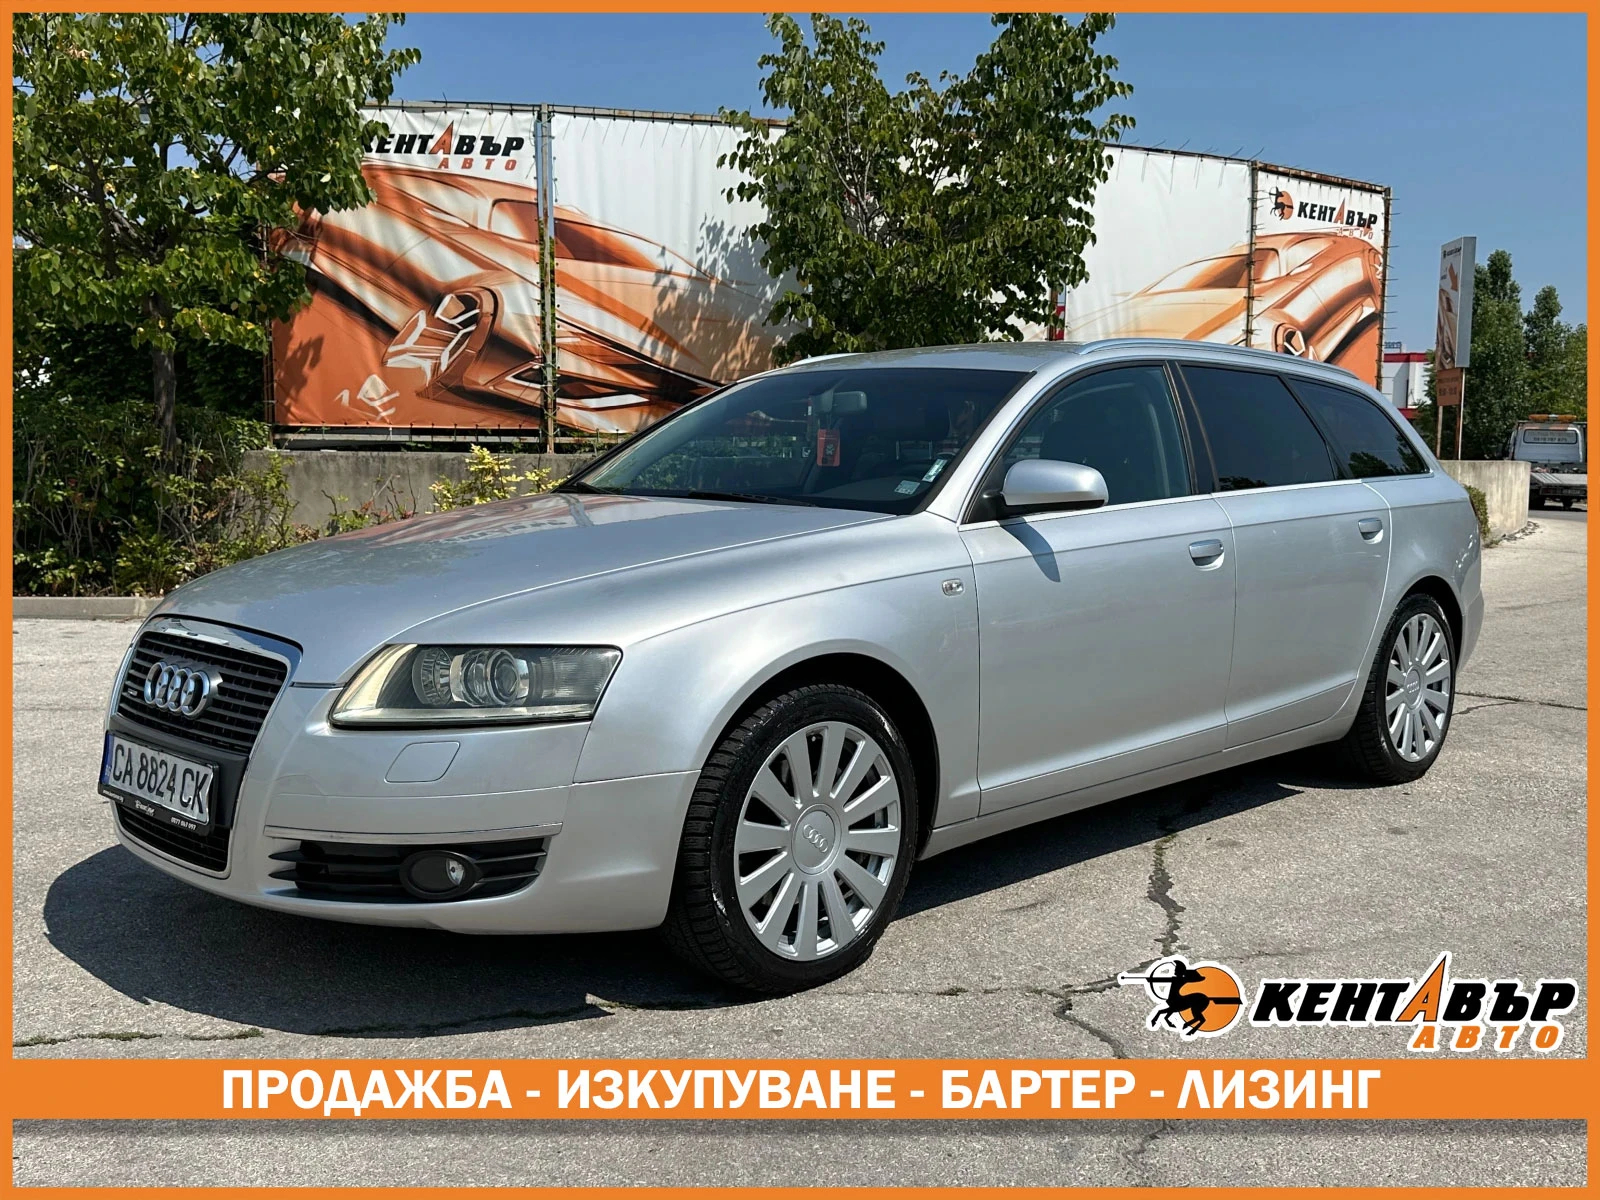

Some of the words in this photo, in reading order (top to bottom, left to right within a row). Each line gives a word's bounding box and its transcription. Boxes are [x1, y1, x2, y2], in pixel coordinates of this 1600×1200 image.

[437, 157, 518, 172] АВТО
[1297, 197, 1378, 229] КЕНТАВЪР
[136, 752, 178, 803] 8824
